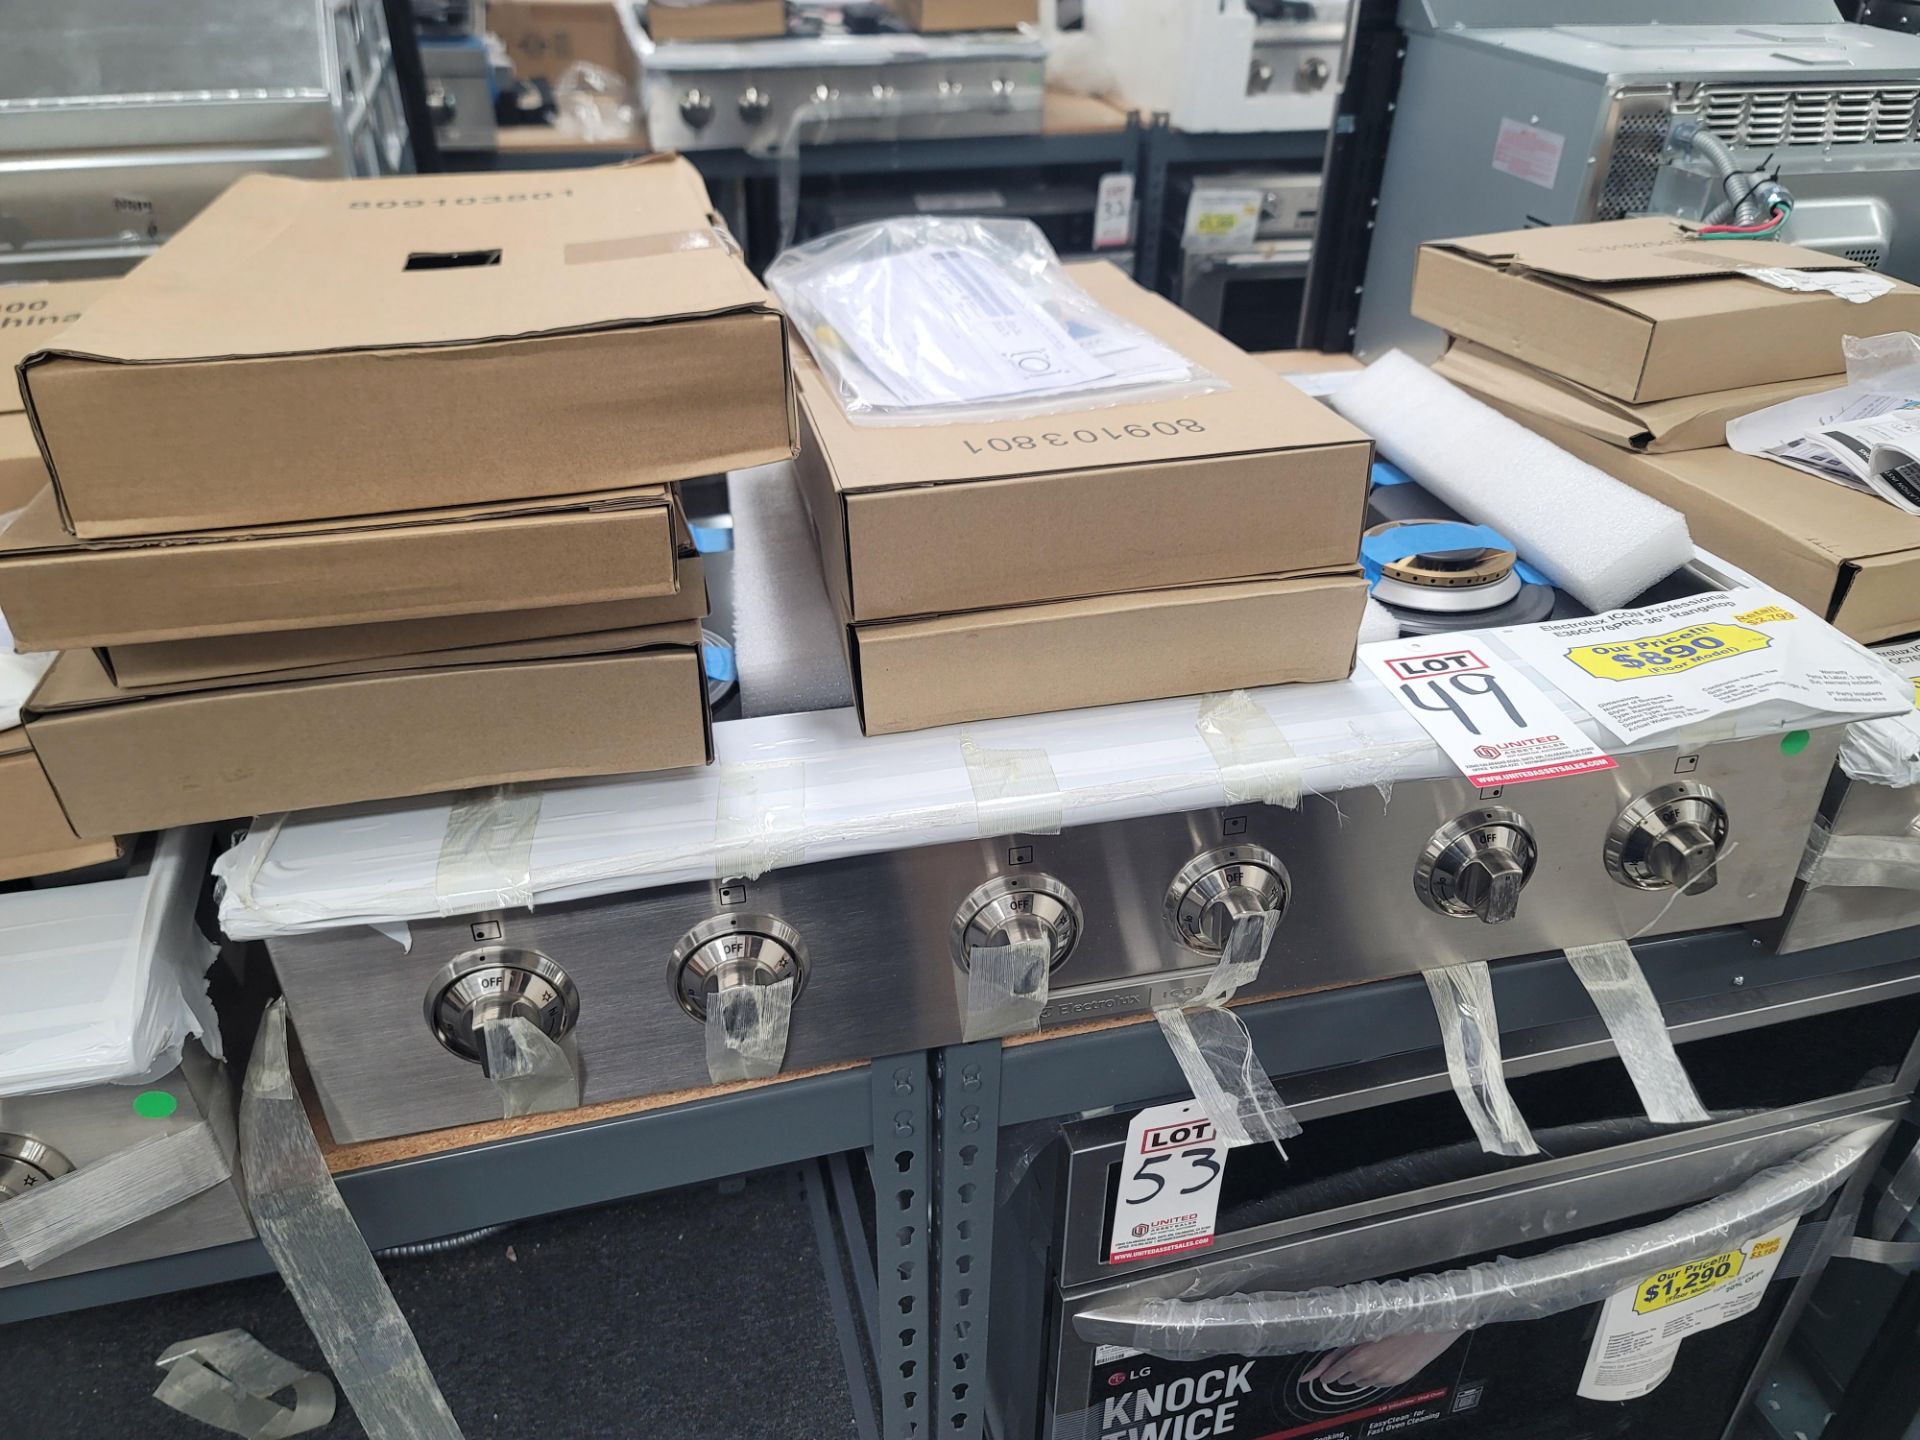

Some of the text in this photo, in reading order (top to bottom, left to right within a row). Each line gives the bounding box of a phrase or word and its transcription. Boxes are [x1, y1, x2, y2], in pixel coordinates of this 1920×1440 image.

[963, 418, 1206, 455] 809103801
[1540, 593, 1729, 632] Electrolux ICON Professional
[1671, 601, 1737, 620] Rangetop
[1591, 626, 1715, 656] Our Price!!!
[1611, 635, 1725, 669] $890
[1399, 655, 1467, 675] LOT
[1647, 646, 1741, 674] (Floor Model)
[1400, 673, 1528, 735] 49
[1496, 734, 1560, 749] UNITED
[1477, 758, 1608, 784] WWW.UNITEDASSETSALES.COM
[1662, 808, 1680, 821] OFF
[1480, 833, 1497, 844] OFF
[1226, 872, 1244, 883] OFF
[1010, 900, 1029, 910] OFF
[724, 943, 743, 955] OFF
[481, 976, 502, 988] OFF
[1059, 993, 1140, 1015] Electrolux
[1151, 1122, 1211, 1148] LOT
[1126, 1148, 1220, 1205] 53
[1151, 1213, 1198, 1227] UNITED
[1113, 1237, 1209, 1261] WWW.UNITEDASSETSALES.COM
[1657, 1253, 1731, 1283] Our Price!!!
[1644, 1262, 1731, 1303] $1,290
[1130, 1366, 1151, 1380] LG
[1103, 1360, 1256, 1430] KNOCK
[1367, 1411, 1440, 1436] Fast Oven Cleaning
[1413, 1409, 1425, 1418] for
